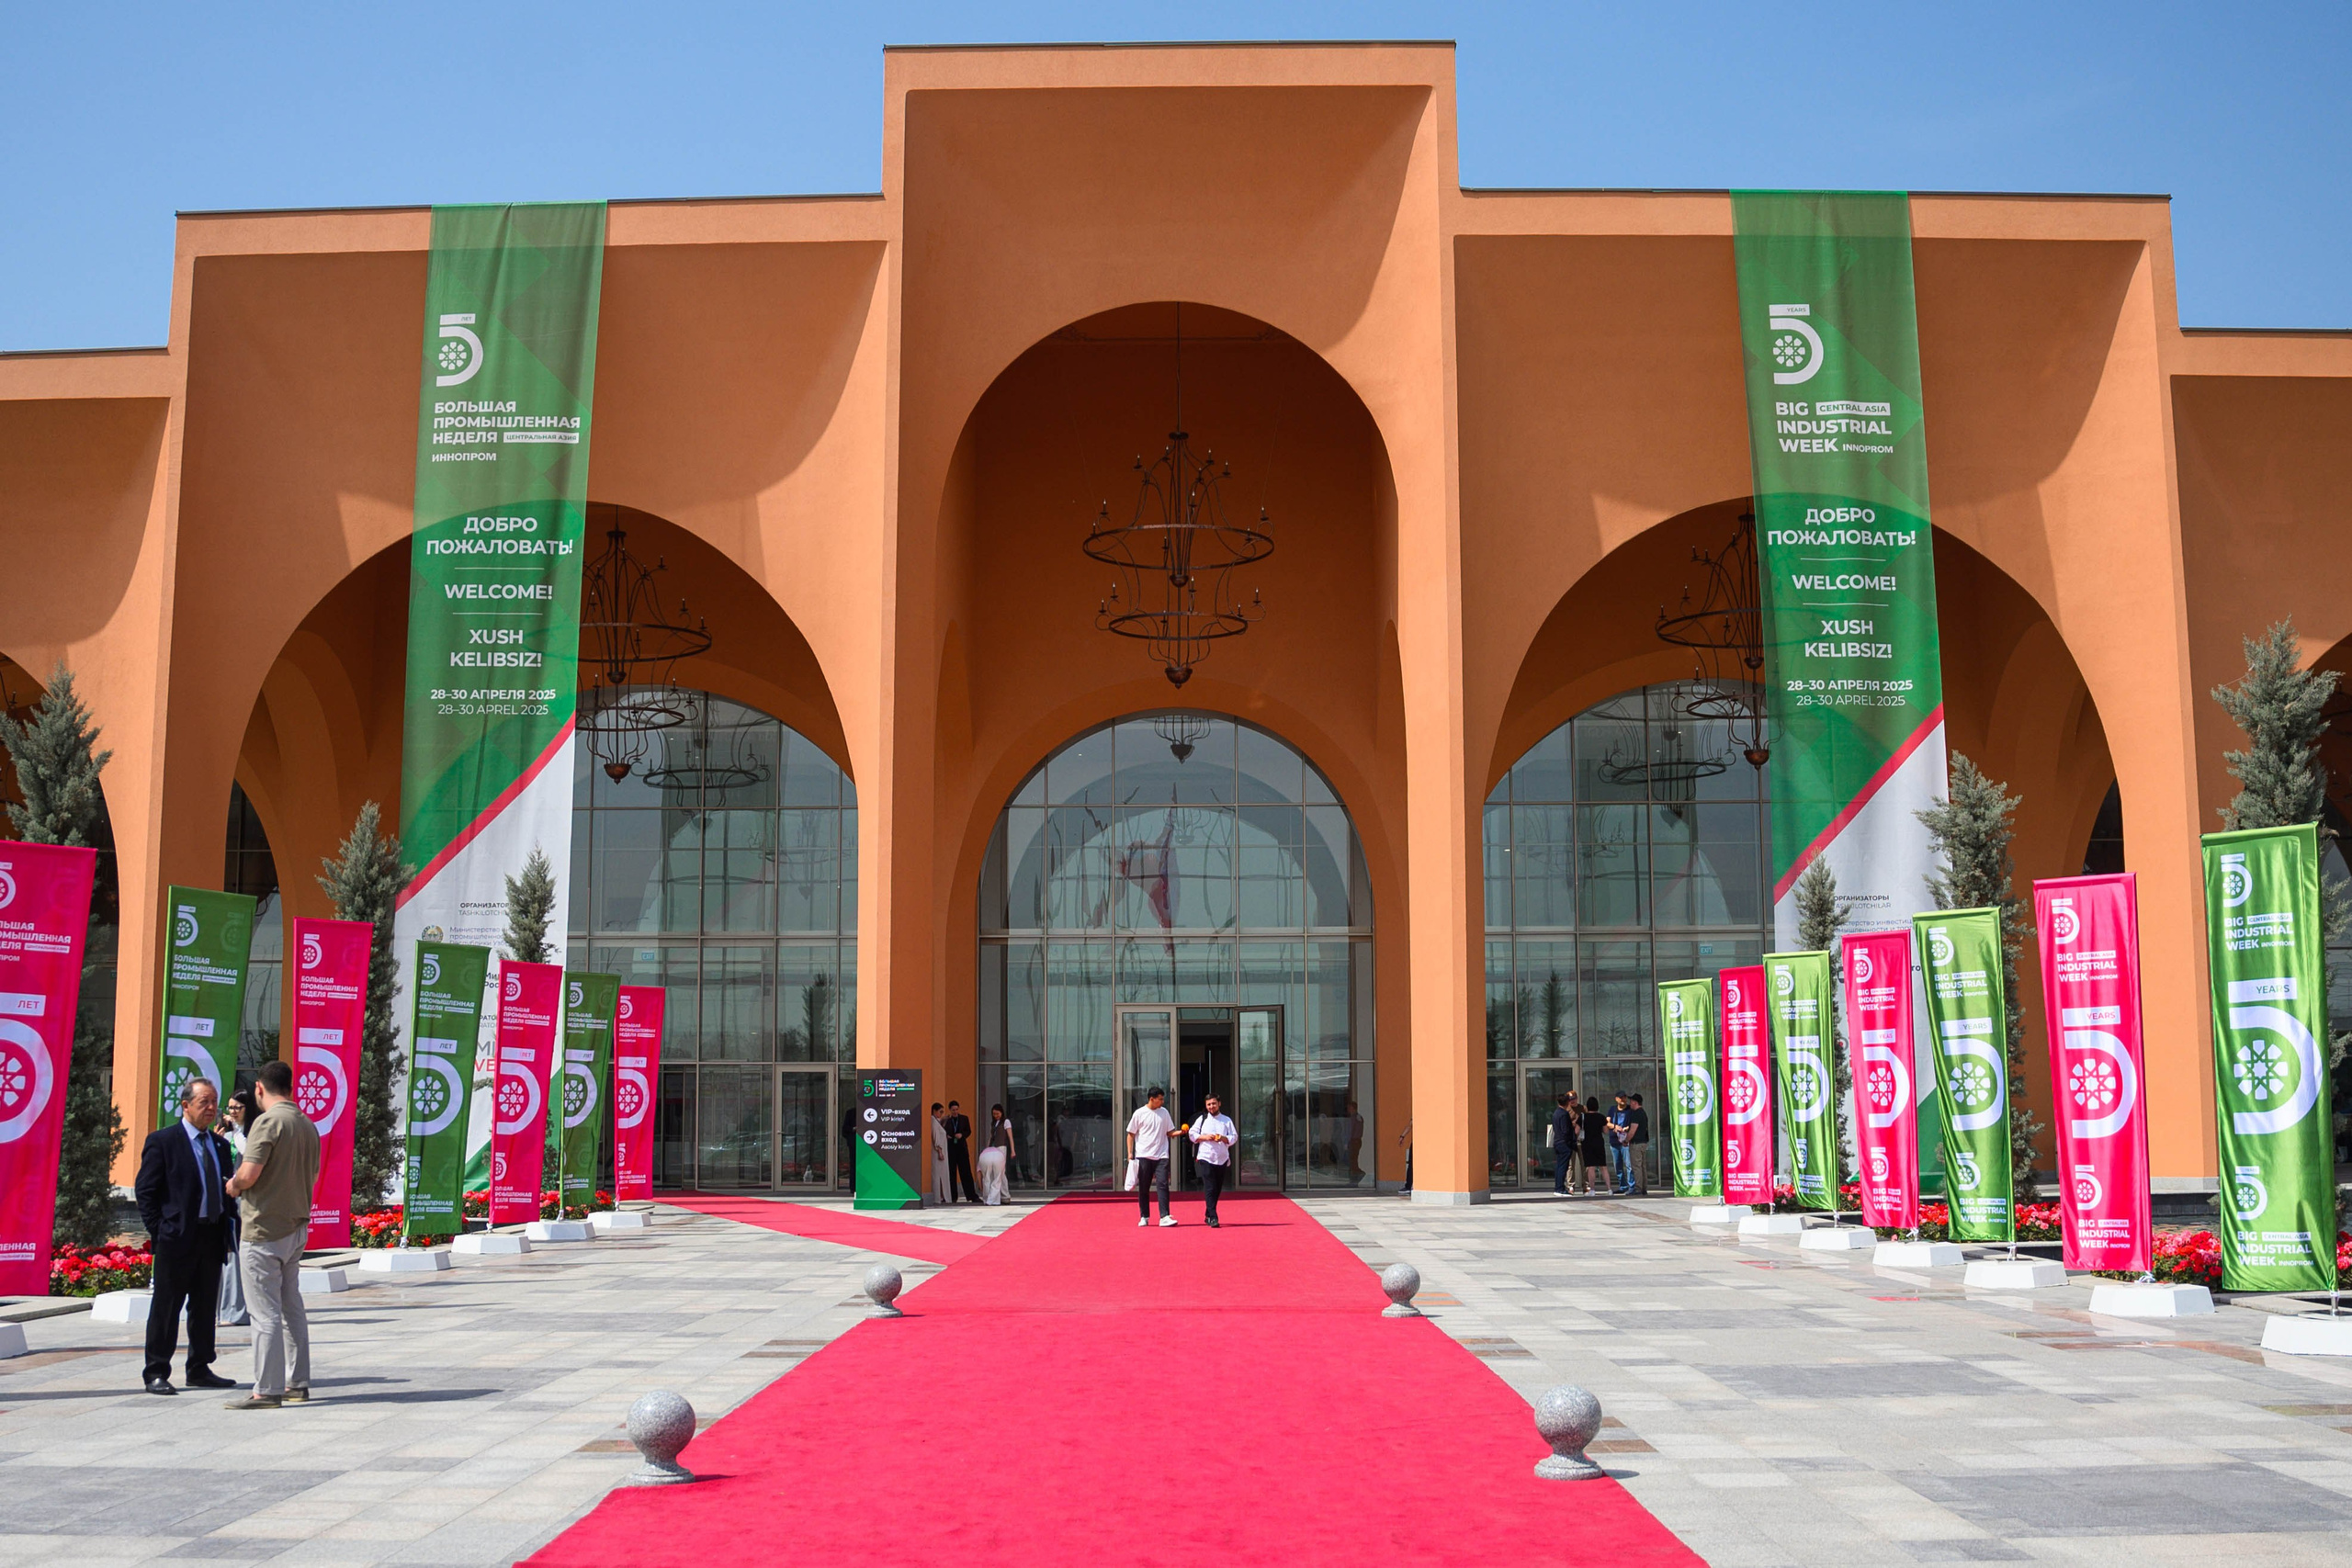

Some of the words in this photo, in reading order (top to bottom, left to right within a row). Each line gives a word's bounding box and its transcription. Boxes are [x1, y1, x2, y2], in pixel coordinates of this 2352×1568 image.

[435, 401, 516, 413] БОЛЬШАЯ
[1775, 402, 1808, 415] BIG
[1819, 404, 1862, 412] CENTRAL
[434, 416, 581, 428] ПРОМЫШЛЕННАЯ
[1777, 419, 1892, 434] INDUSTRIAL
[433, 432, 498, 445] НЕДЕЛЯ
[1779, 438, 1838, 453] WEEK
[1842, 444, 1894, 454] INNOPROM
[432, 453, 496, 462] ИННОПРОМ
[1804, 507, 1876, 525] ДОБРО
[464, 517, 537, 534] ДОБРО
[1768, 529, 1917, 547] ПОЖАЛОВАТЬ!
[426, 539, 573, 555] ПОЖАЛОВАТЬ!
[1792, 574, 1897, 591] WELCOME!
[445, 584, 553, 600] WELCOME!
[1821, 620, 1873, 635] XUSH
[469, 629, 523, 644] XUSH
[1804, 643, 1893, 659] KELIBSIZ!
[450, 652, 542, 667] KELIBSIZ!
[1827, 680, 1880, 691] АПРЕЛЯ
[1883, 680, 1913, 692] 2025
[470, 690, 525, 700] АПРЕЛЯ
[528, 689, 556, 700] 2025
[1835, 694, 1875, 705] APREL
[1877, 695, 1905, 706] 2025
[476, 705, 518, 715] APREL
[521, 705, 548, 715] 2025
[2224, 917, 2244, 927] BIG
[2225, 925, 2294, 939] INDUSTRIAL
[2226, 939, 2259, 951] WEEK
[174, 954, 209, 964] БОЛЬШАЯ
[2057, 953, 2073, 962] BIG
[174, 964, 237, 976] ПРОМЫШЛЕННАЯ
[2058, 961, 2117, 972] INDUSTRIAL
[173, 972, 201, 980] НЕДЕЛЯ
[301, 976, 334, 984] БОЛЬШАЯ
[2059, 973, 2088, 982] WEEK
[300, 983, 358, 992] ПРОМЫШЛЕННАЯ
[1936, 979, 1987, 989] INDUSTRIAL
[2256, 984, 2290, 994] YEARS
[1858, 995, 1894, 1004] INDUSTRIAL
[1937, 990, 1962, 998] WEEK
[17, 999, 40, 1010] ЛЕТ
[1961, 1214, 1987, 1223] WEEK
[2078, 1219, 2095, 1227] BIG
[2078, 1229, 2130, 1238] INDUSTRIAL
[2237, 1231, 2257, 1240] BIG
[2079, 1239, 2109, 1248] WEEK
[2237, 1244, 2312, 1254] INDUSTRIAL
[2238, 1255, 2276, 1266] WEEK
